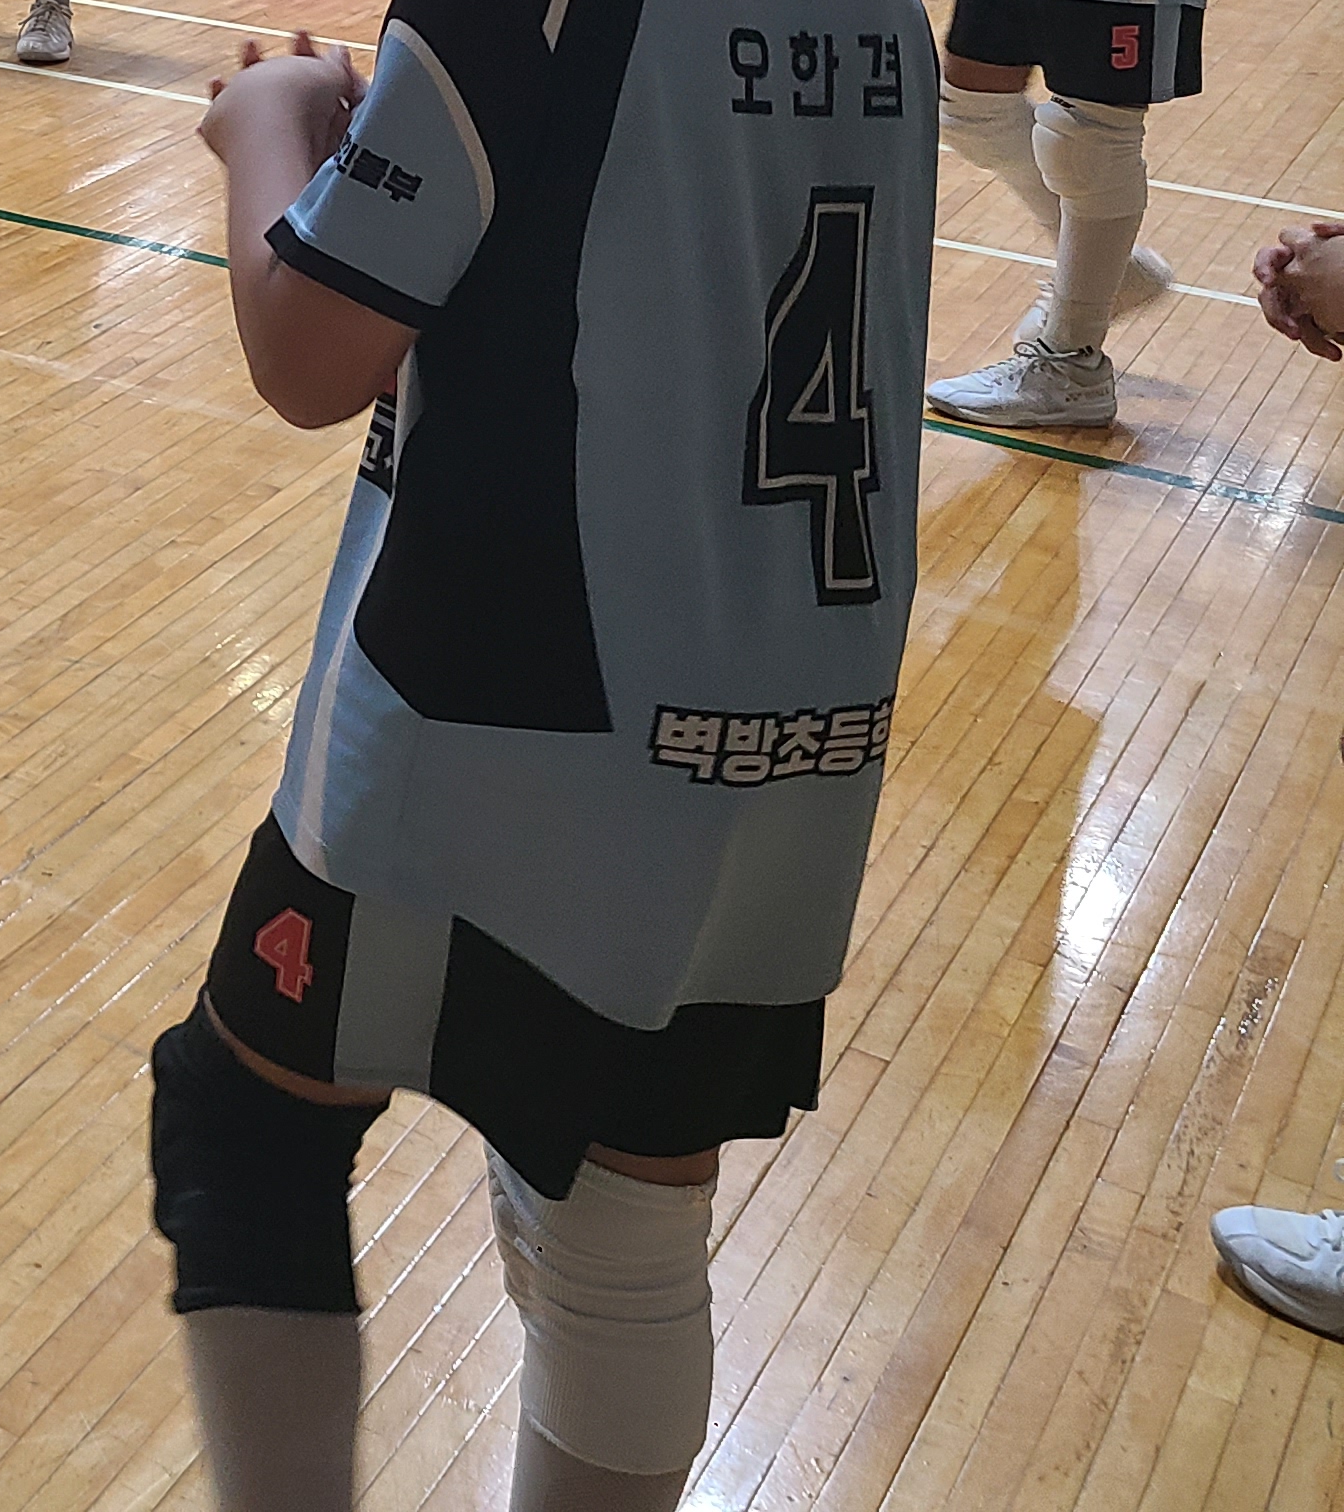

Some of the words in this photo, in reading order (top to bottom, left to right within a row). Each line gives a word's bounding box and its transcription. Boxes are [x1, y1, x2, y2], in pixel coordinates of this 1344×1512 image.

[729, 26, 904, 119] 오한겸
[1111, 25, 1141, 70] 5
[742, 185, 881, 606] 4
[252, 907, 312, 1003] 4
